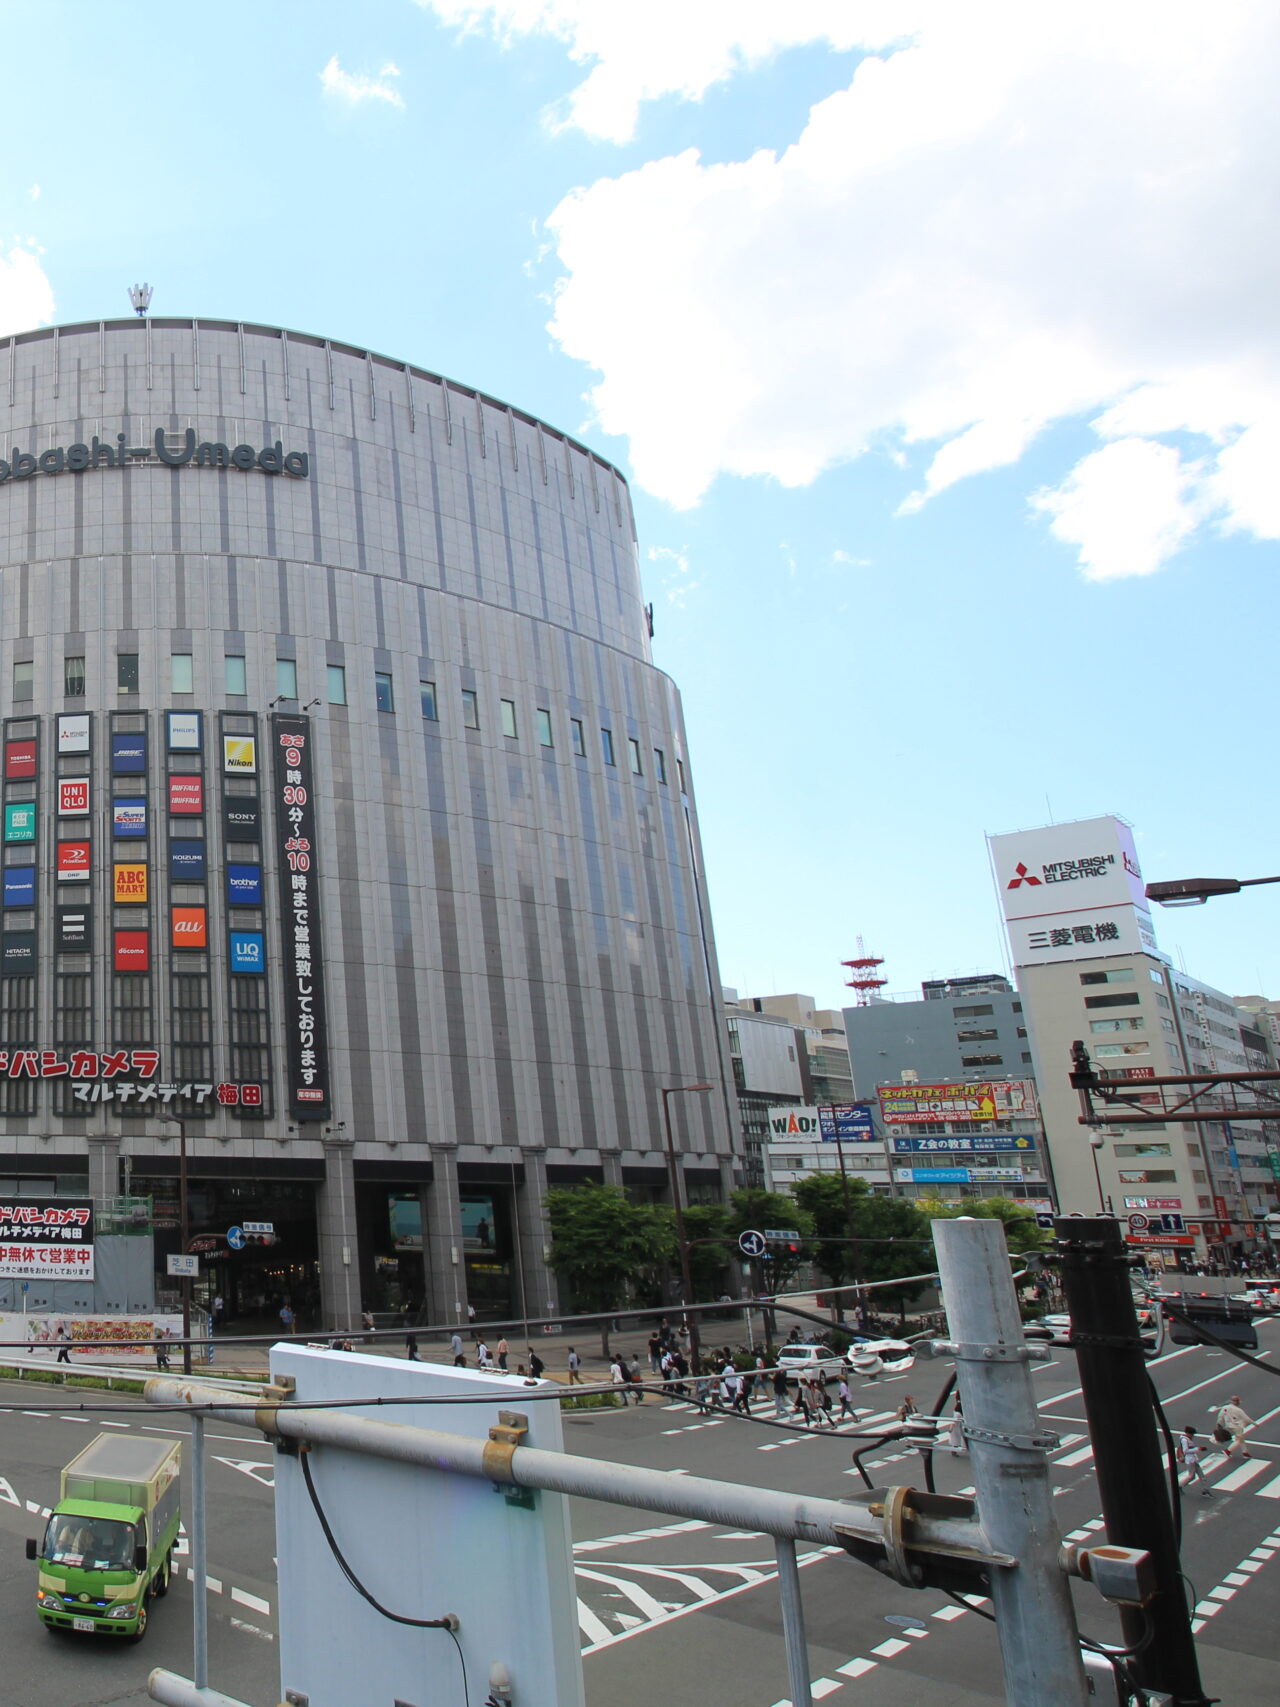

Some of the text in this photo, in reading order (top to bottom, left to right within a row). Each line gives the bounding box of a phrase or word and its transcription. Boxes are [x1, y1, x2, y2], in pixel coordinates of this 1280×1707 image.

[228, 759, 253, 767] Nikon
[63, 787, 83, 796] UNI
[63, 797, 84, 807] QLO
[8, 831, 33, 839] エコリカ
[1042, 854, 1115, 874] MITSUBISHI
[117, 871, 144, 883] ABC
[1044, 866, 1108, 884] ELECTRIC
[230, 878, 258, 886] brother
[117, 885, 144, 893] MART
[175, 921, 203, 932] au
[1028, 922, 1120, 950] 三菱電機
[236, 943, 258, 956] UQ
[72, 1082, 262, 1106] マルチメディア梅田
[772, 1112, 817, 1133] WAO!
[918, 1139, 972, 1149] Z会の教室
[1132, 1217, 1144, 1225] 40
[172, 1257, 194, 1268] 芝田
